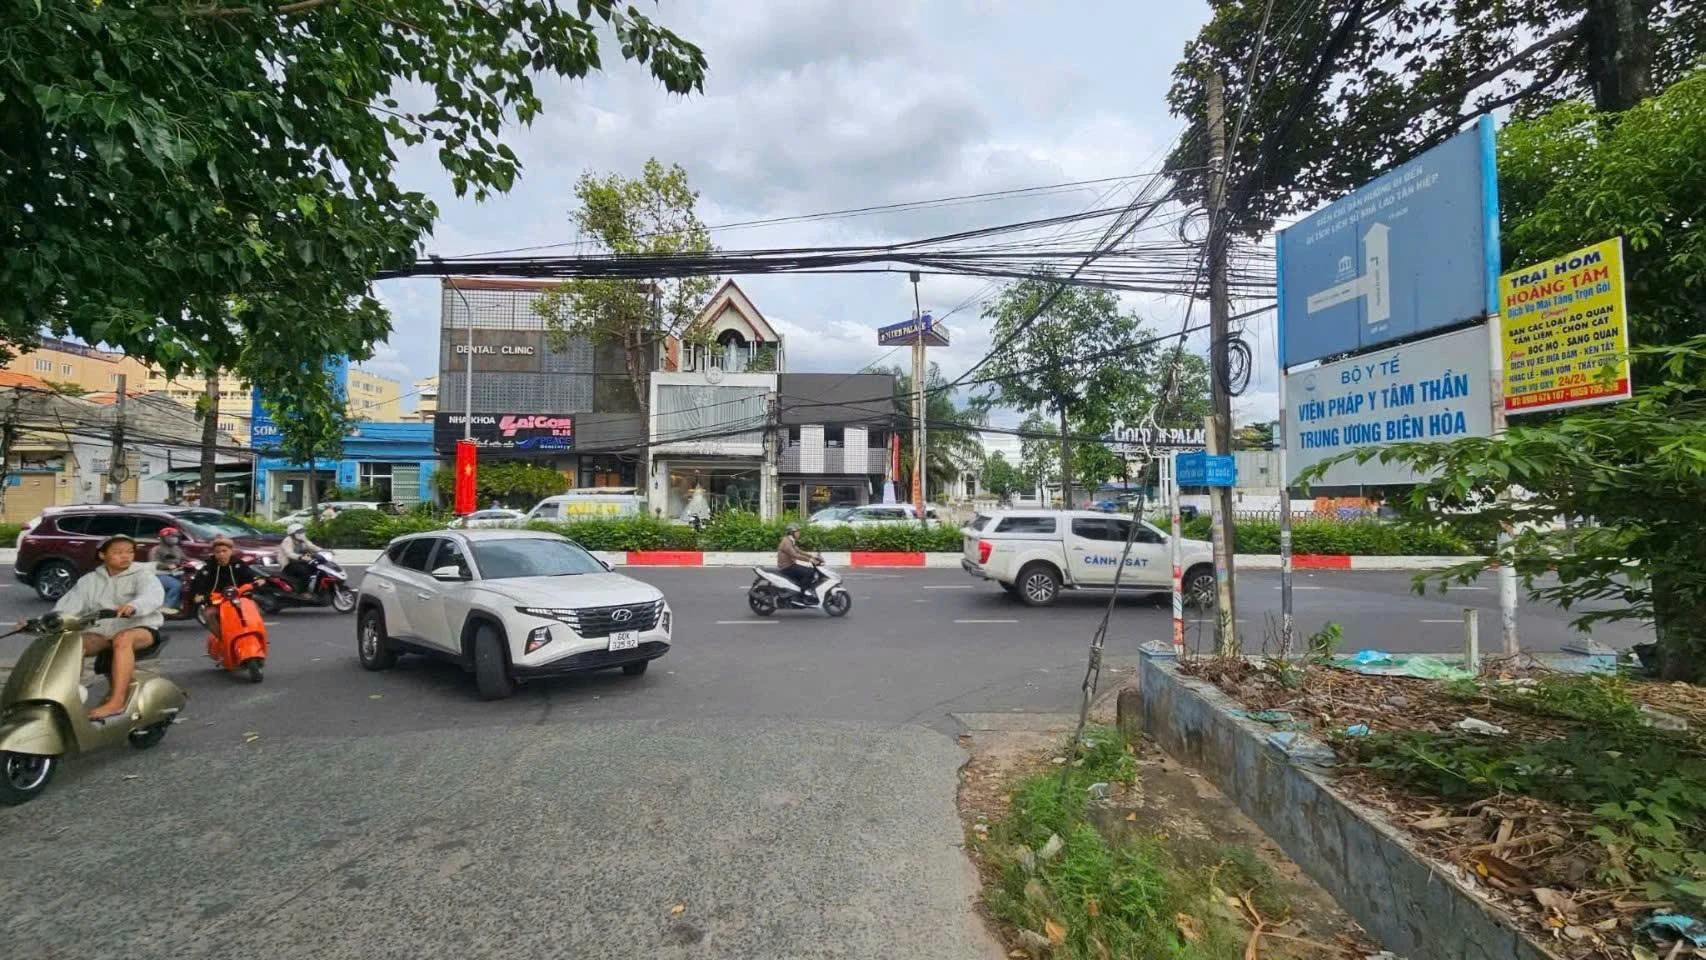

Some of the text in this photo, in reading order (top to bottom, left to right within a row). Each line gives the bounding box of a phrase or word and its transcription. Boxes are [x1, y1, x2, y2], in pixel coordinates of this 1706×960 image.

[1570, 264, 1609, 290] TÂM
[501, 346, 534, 355] CLINIC
[1341, 352, 1401, 385] BỘ Y TẾ
[1298, 368, 1469, 424] VIỆN PHÁP Y TÂM THẦN
[1299, 407, 1467, 449] TRUNG ƯƠNG BIÊN HÒA
